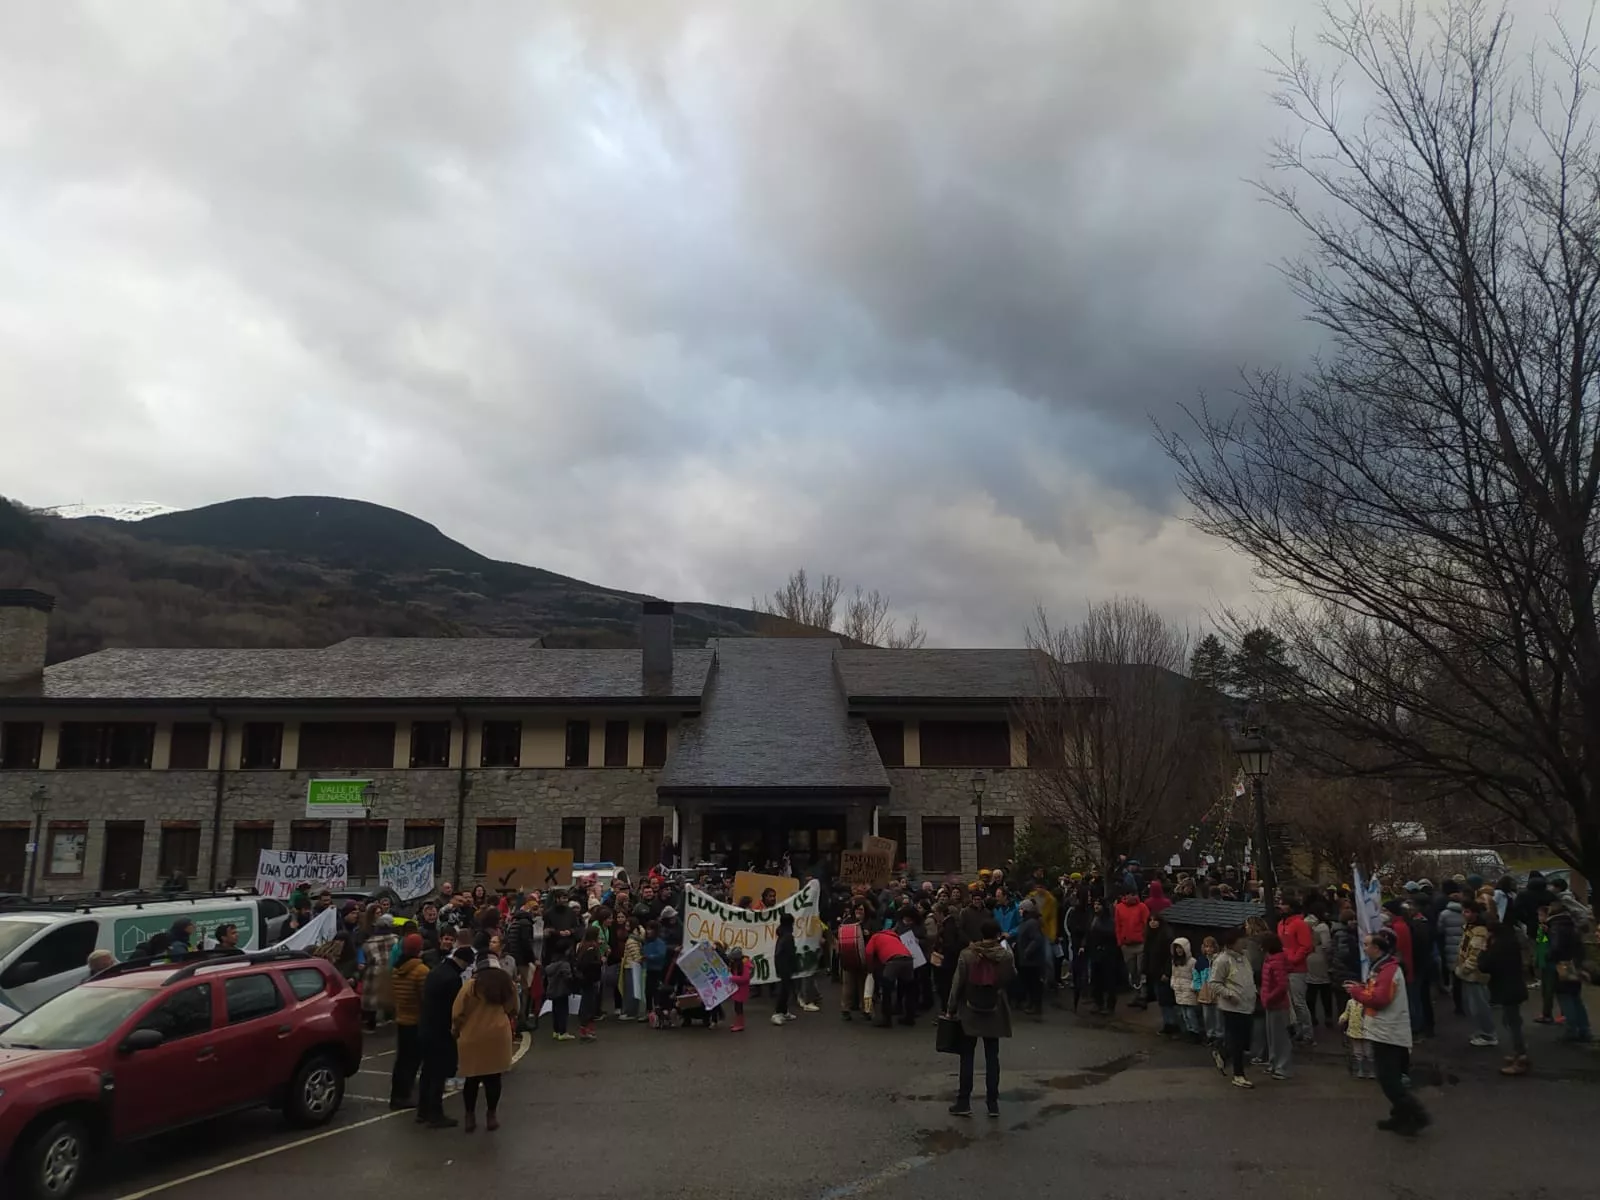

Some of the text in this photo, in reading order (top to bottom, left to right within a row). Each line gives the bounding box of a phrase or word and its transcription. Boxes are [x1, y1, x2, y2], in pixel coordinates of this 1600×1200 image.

[320, 785, 361, 794] VALLE DE
[279, 852, 337, 866] UN VALLE
[260, 862, 346, 880] UNA COMUNIDAD
[793, 886, 813, 911] DE
[686, 912, 758, 950] CALIDAD
